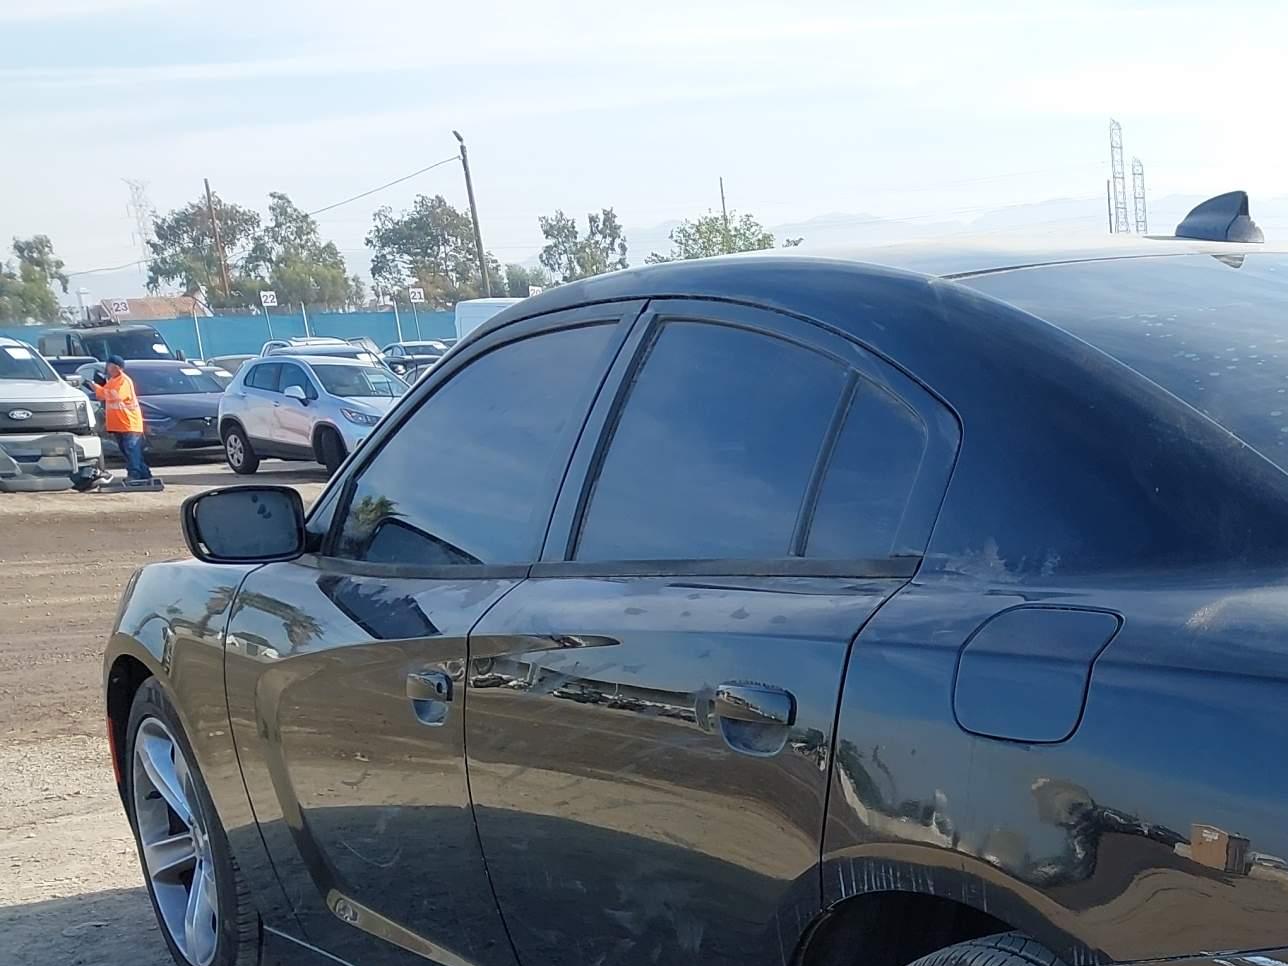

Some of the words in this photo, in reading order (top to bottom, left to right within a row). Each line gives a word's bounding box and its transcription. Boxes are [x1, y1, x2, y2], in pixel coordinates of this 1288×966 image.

[262, 293, 277, 304] 22
[411, 290, 424, 301] 21
[114, 301, 128, 312] 23
